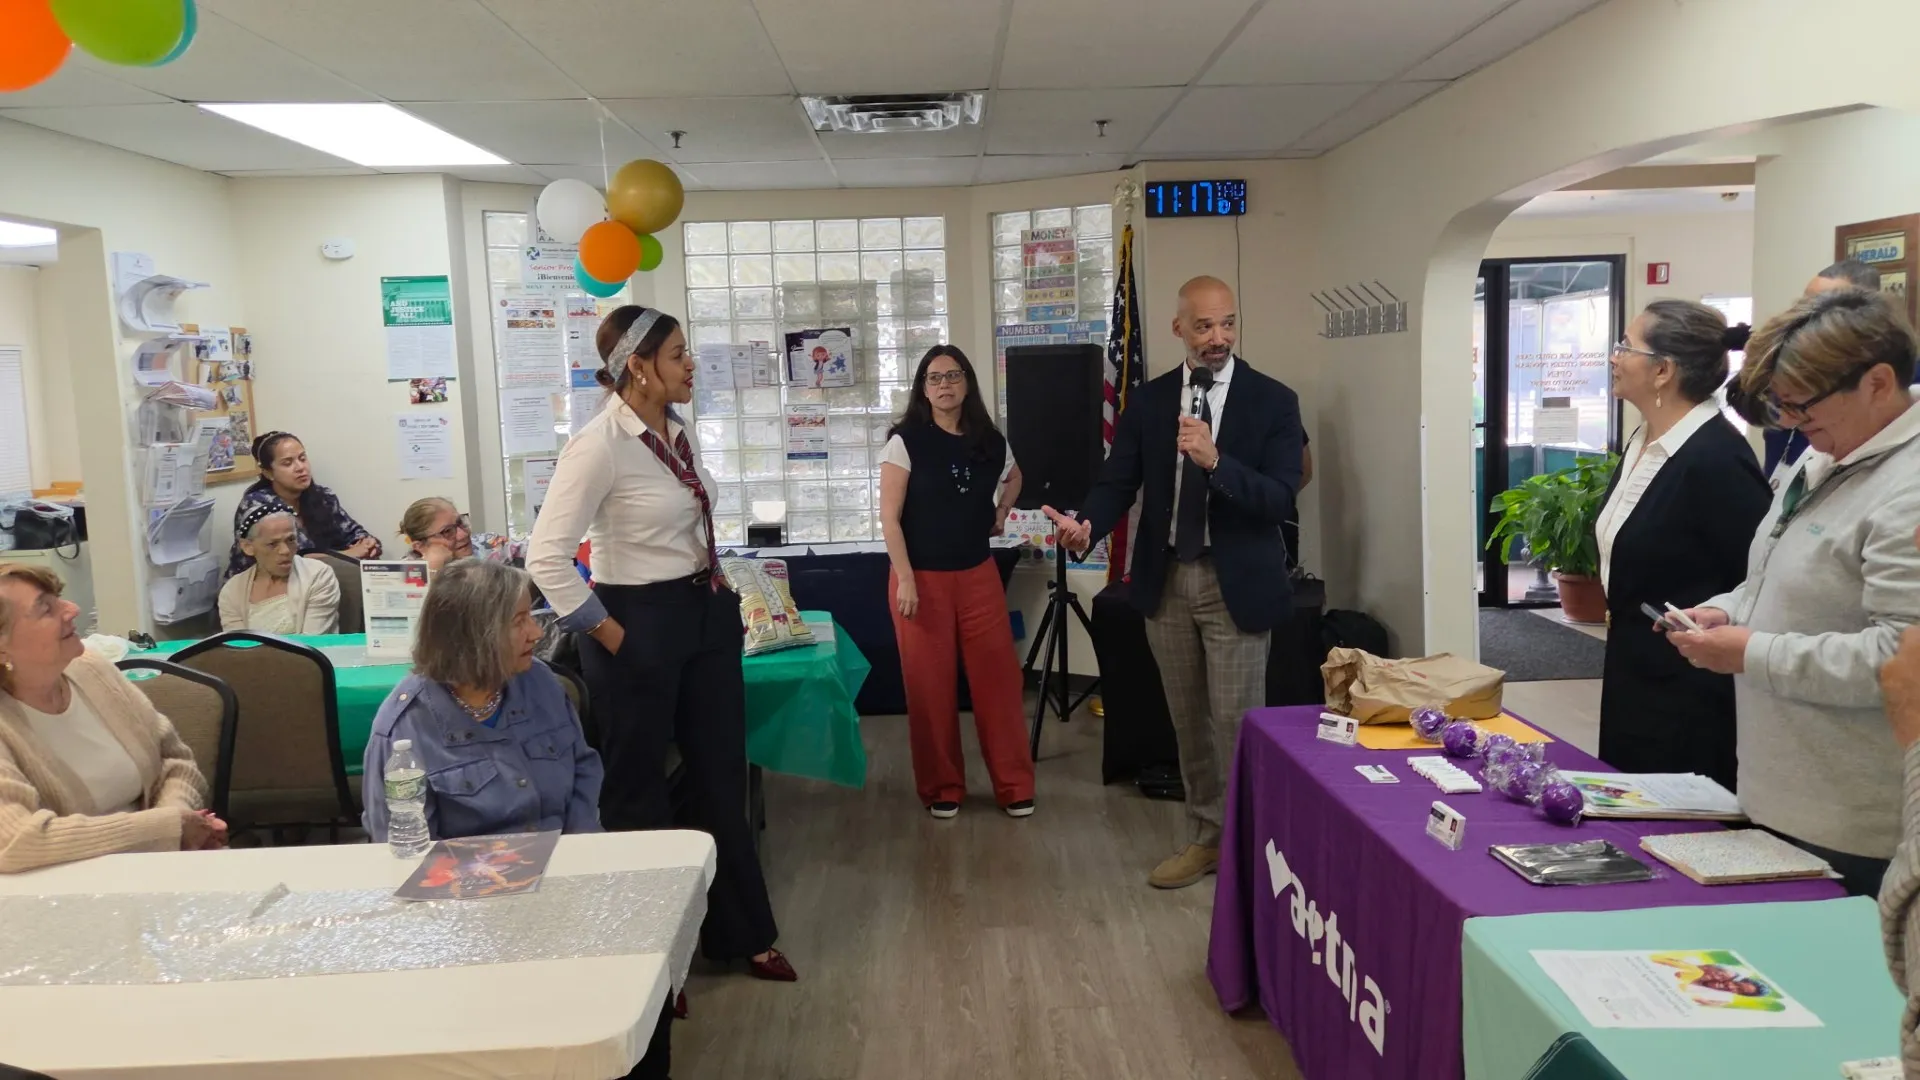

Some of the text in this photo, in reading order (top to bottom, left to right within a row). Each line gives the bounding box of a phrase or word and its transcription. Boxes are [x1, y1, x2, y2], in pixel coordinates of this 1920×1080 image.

[1157, 182, 1212, 214] 11:17
[1031, 229, 1067, 241] MONEY
[1856, 246, 1898, 262] HERALD
[1002, 326, 1046, 336] NUMBERS
[1066, 322, 1090, 333] TIME
[1291, 871, 1386, 1057] aetna
